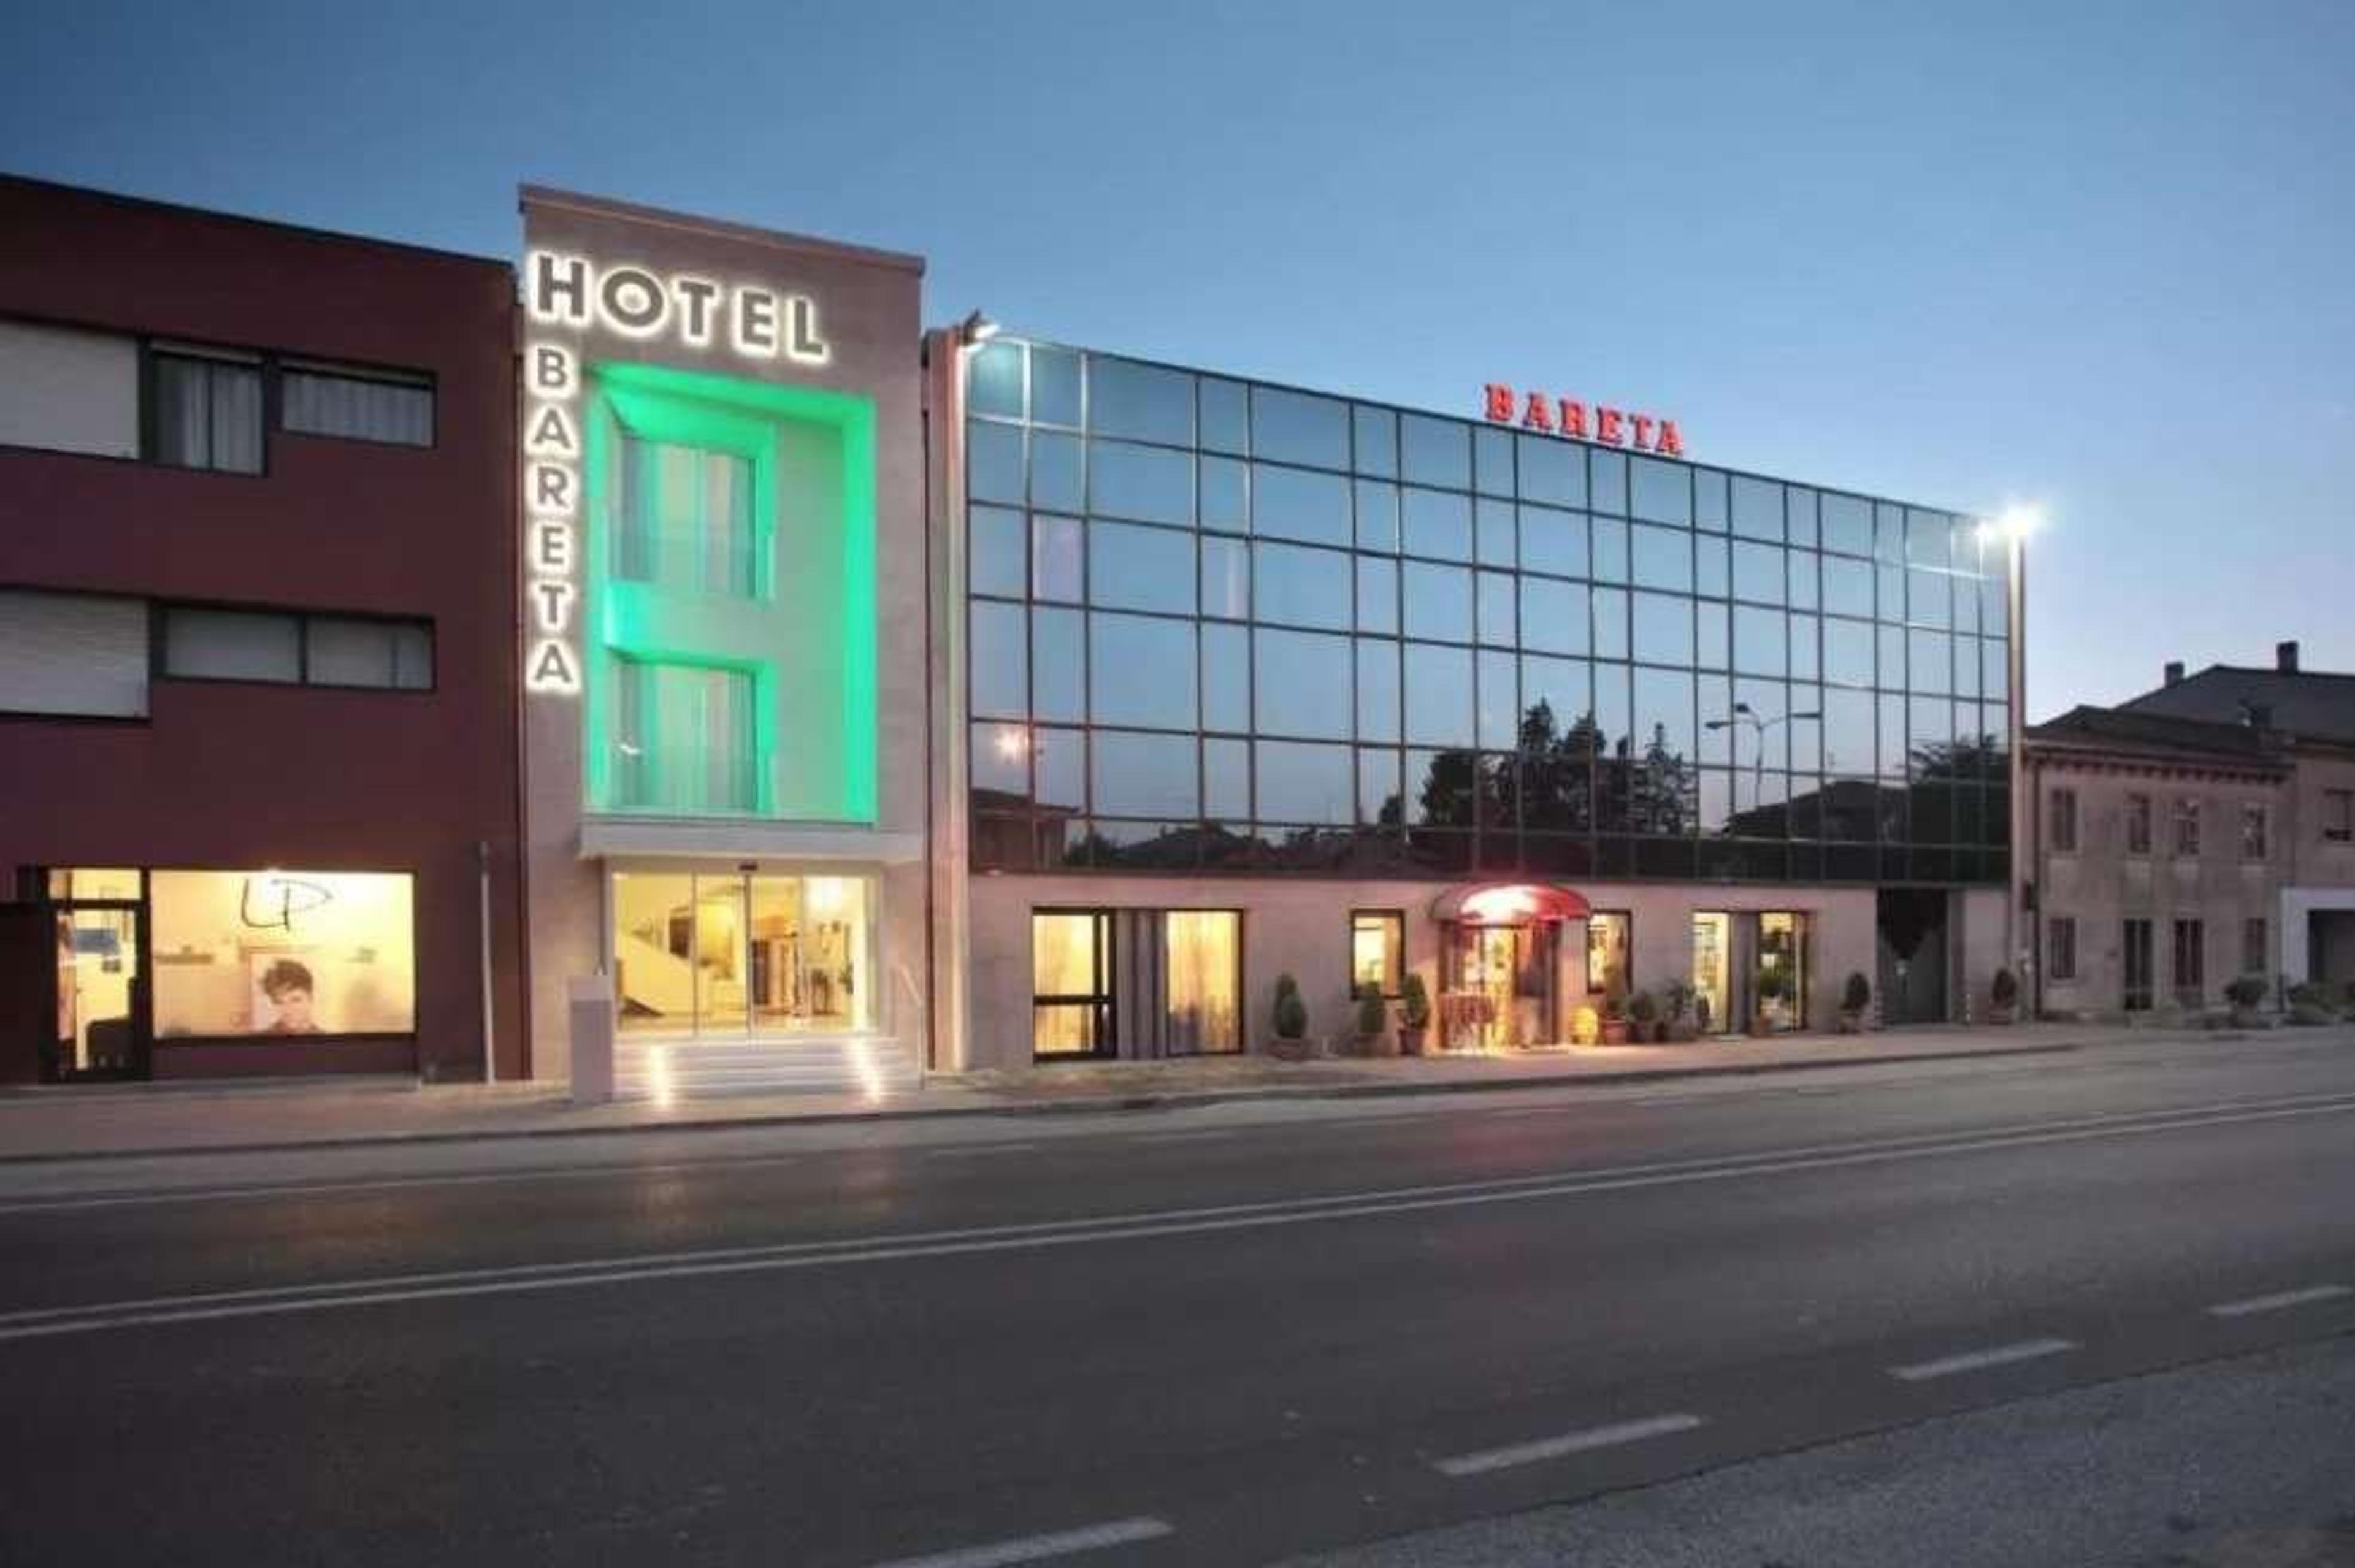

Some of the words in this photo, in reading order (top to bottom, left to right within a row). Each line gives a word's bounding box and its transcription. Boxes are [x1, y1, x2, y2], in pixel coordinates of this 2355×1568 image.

[532, 252, 827, 359] HOTEL
[1484, 383, 1683, 454] BARETA
[530, 343, 576, 687] BARETA
